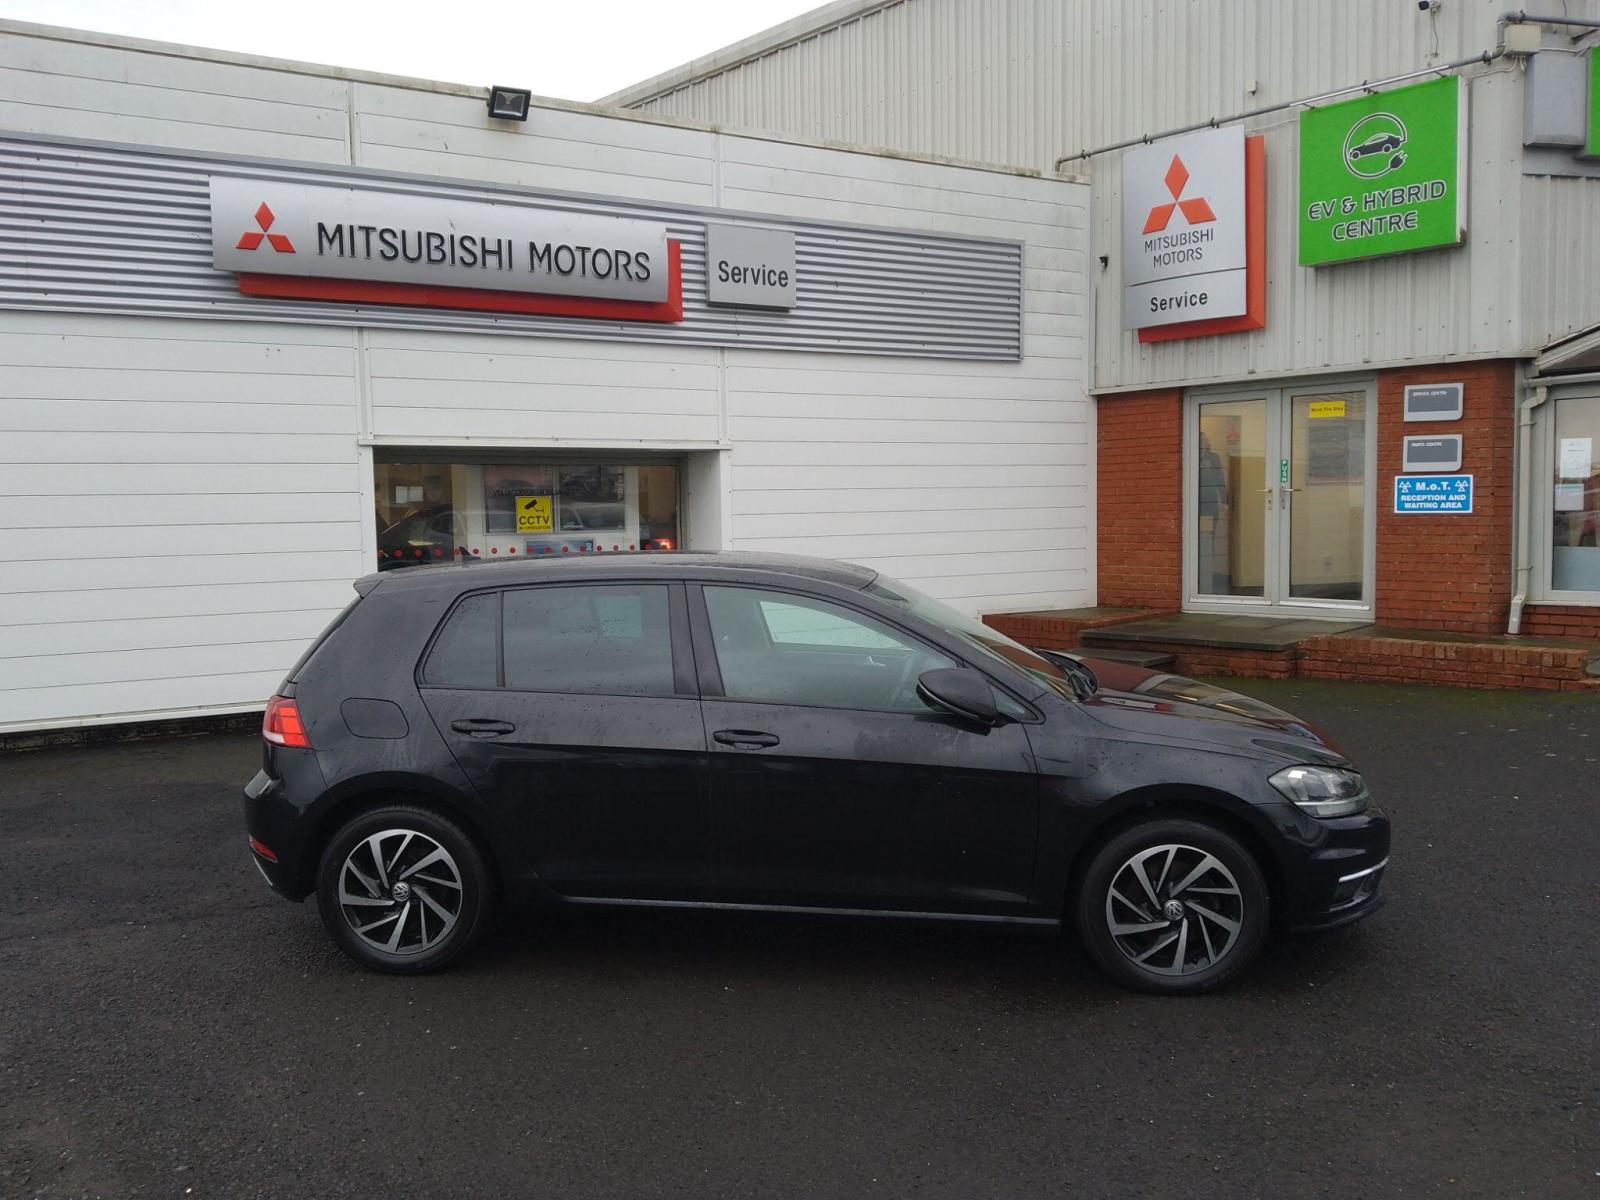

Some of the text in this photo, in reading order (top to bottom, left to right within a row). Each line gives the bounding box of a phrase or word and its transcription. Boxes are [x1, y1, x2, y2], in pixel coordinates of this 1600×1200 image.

[1308, 180, 1447, 220] EV & HYBRID
[1332, 210, 1418, 241] CENTRE
[1144, 228, 1214, 253] MITSUBISHI
[317, 222, 651, 281] MITSUBISHI MOTORS
[1153, 247, 1203, 268] MOTORS
[718, 260, 789, 288] Service
[1150, 291, 1208, 312] Service
[1416, 481, 1451, 491] M.o.T.
[1401, 494, 1447, 502] RECEPTION
[1440, 501, 1463, 509] AREA
[519, 515, 550, 526] CCTV
